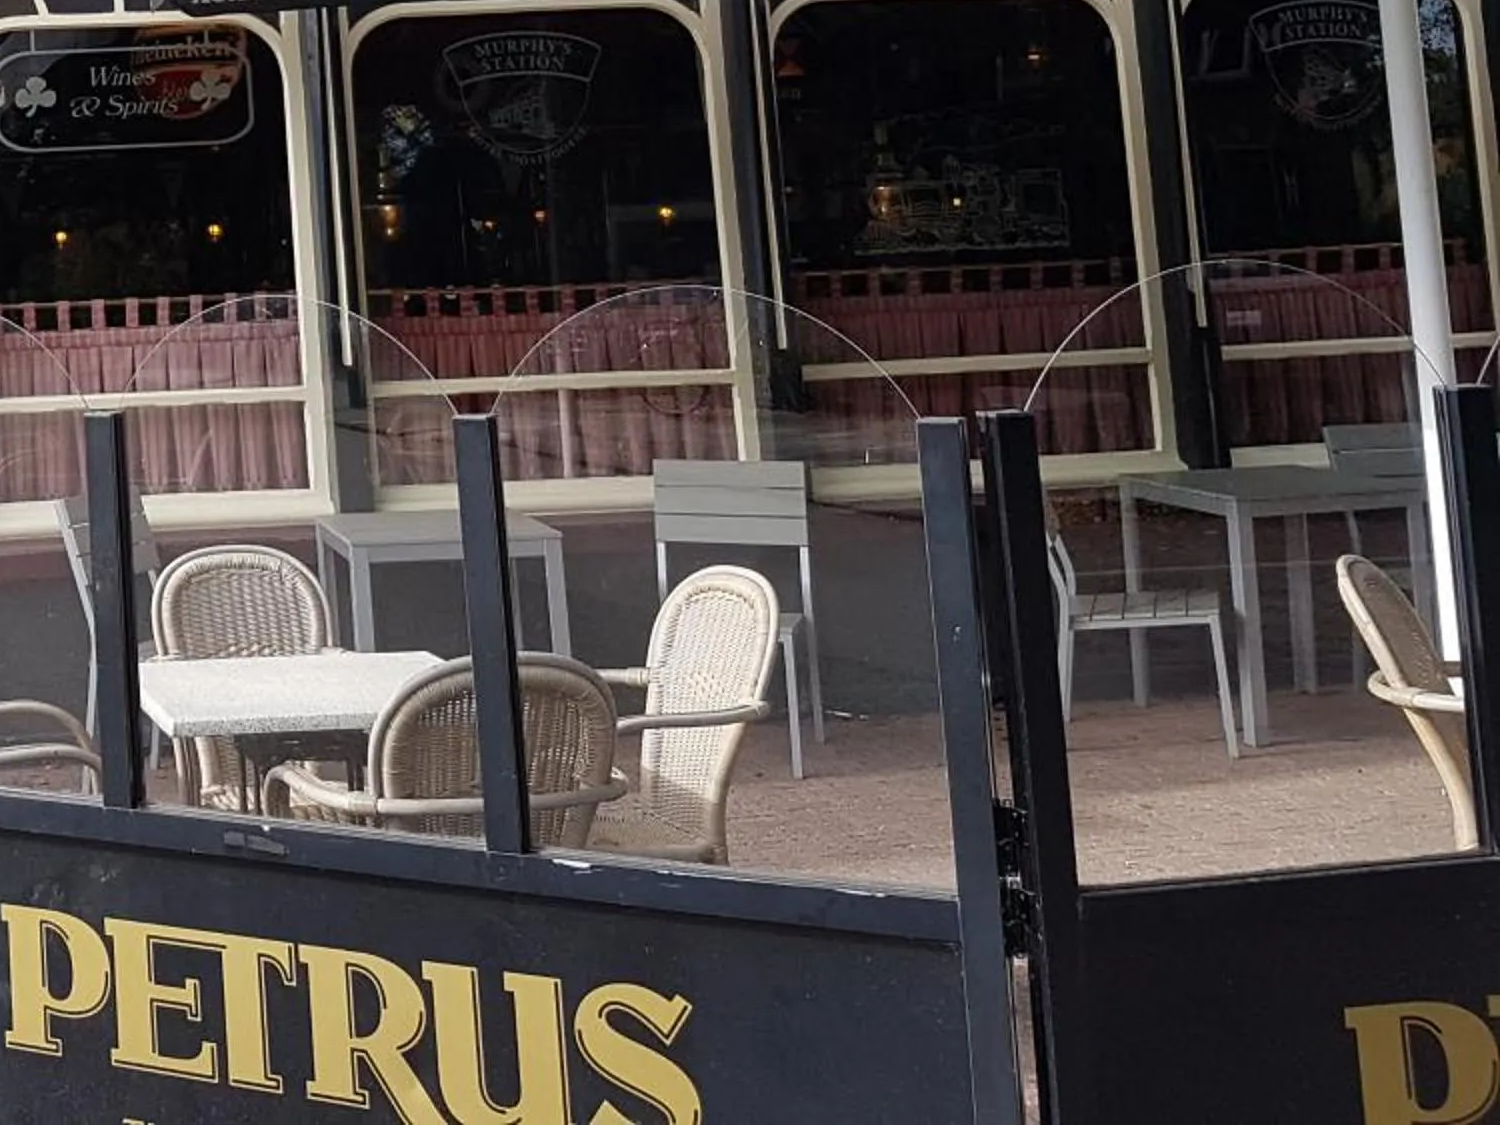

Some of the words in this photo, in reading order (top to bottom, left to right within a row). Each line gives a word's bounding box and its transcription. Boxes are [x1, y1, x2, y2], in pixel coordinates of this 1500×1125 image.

[1284, 22, 1362, 39] STATION
[473, 38, 572, 59] MURPHY'S
[481, 55, 566, 72] STATION
[88, 65, 157, 88] Wines
[104, 92, 180, 120] Spirits
[0, 902, 702, 1125] PETRUS
[1344, 993, 1500, 1125] P
